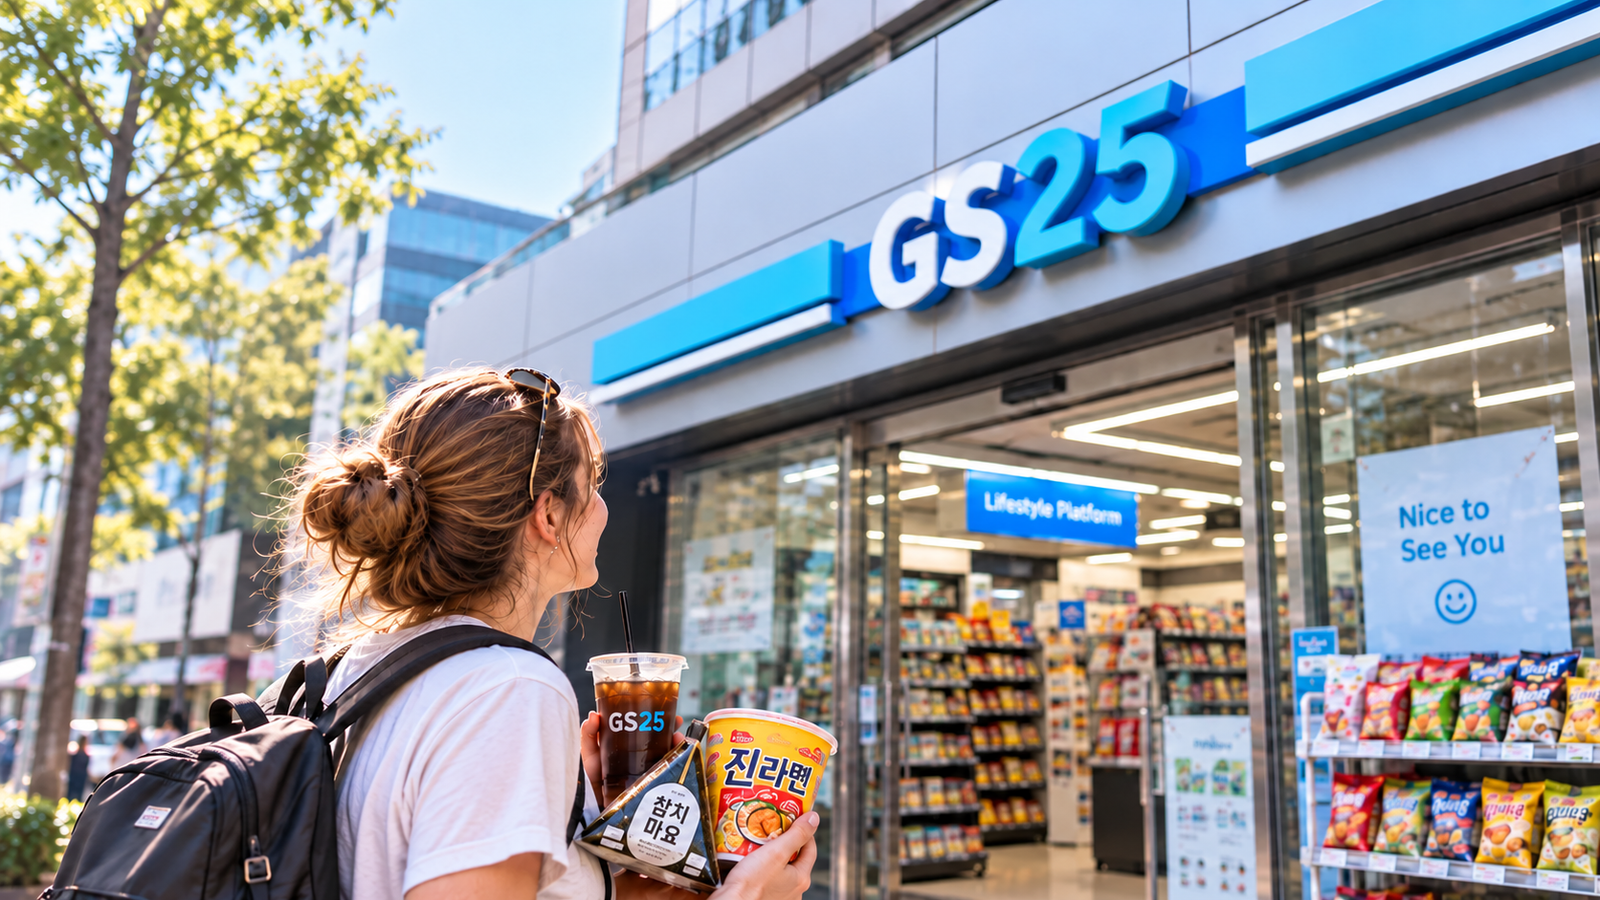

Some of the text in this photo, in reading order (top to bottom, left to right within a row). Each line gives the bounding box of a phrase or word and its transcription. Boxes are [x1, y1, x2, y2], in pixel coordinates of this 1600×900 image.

[869, 79, 1189, 312] GS25
[984, 491, 1122, 527] Lifestyle Platform
[1399, 499, 1490, 529] Nice to
[1401, 532, 1505, 563] See You
[608, 710, 665, 733] GS25
[652, 795, 690, 825] 참치
[643, 817, 681, 846] 마요
